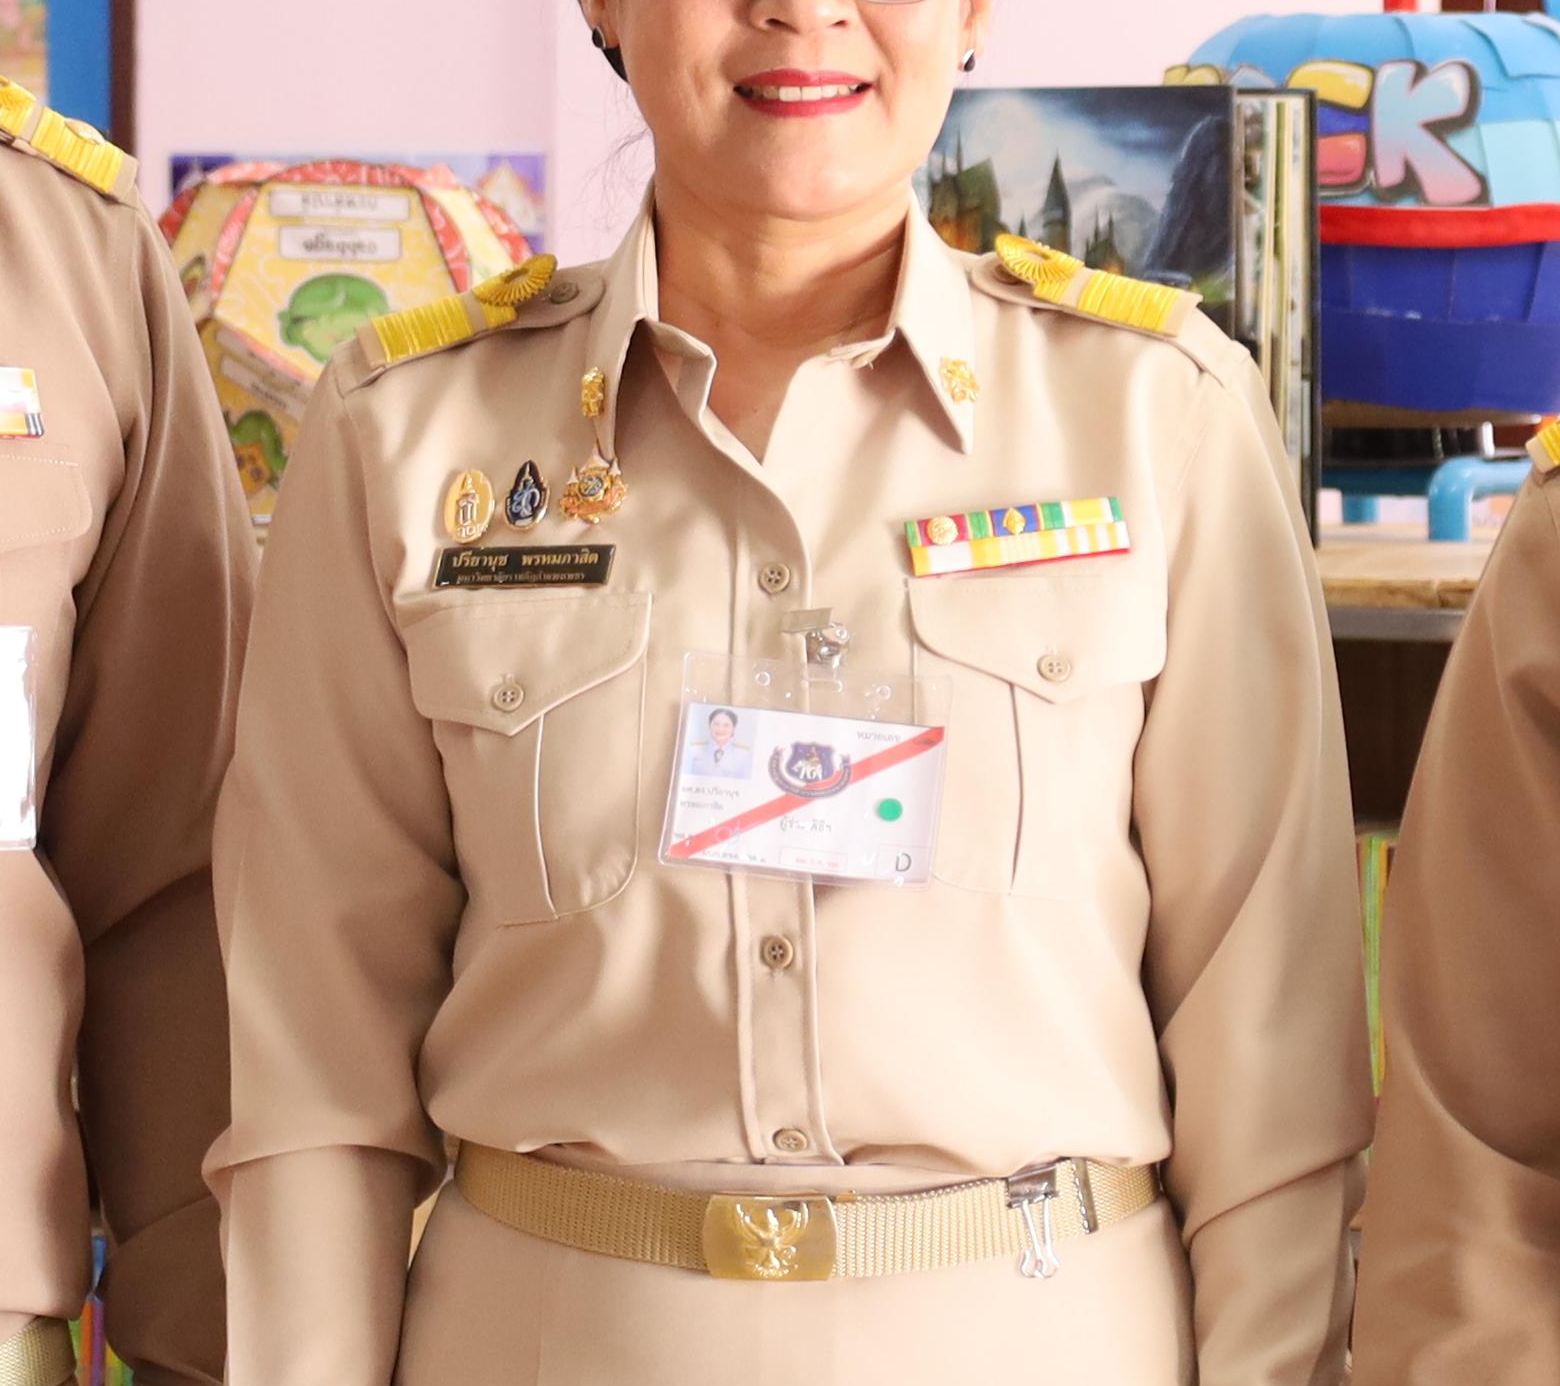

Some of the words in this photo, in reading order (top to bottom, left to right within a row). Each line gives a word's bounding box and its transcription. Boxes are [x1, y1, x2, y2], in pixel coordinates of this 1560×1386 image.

[452, 553, 508, 572] ปรียานุช
[895, 853, 911, 872] D
